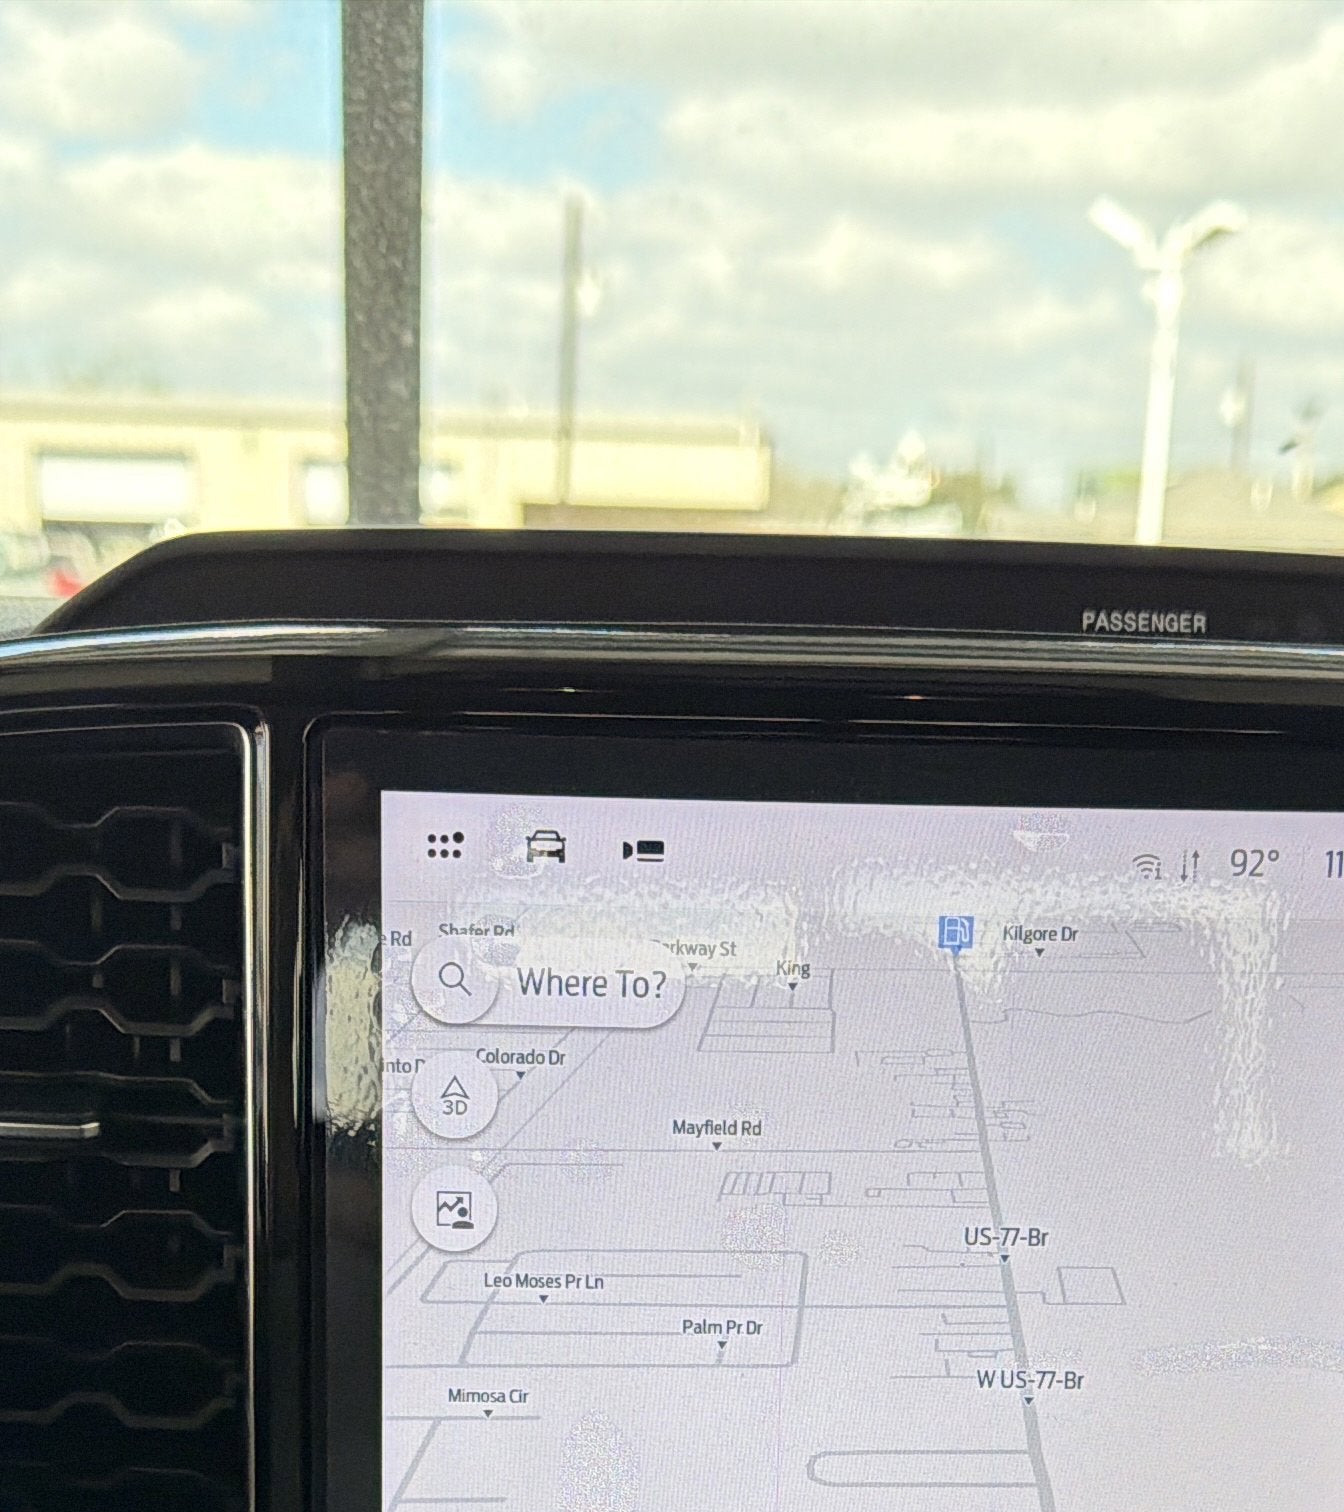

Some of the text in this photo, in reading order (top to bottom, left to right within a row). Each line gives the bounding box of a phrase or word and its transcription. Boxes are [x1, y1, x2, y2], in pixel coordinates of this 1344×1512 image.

[1082, 609, 1206, 634] PASSENGER
[390, 930, 412, 947] Rd
[1002, 924, 1079, 945] Kilgore Dr
[719, 941, 737, 957] St
[776, 960, 810, 979] King
[517, 967, 668, 999] Where To?
[476, 1047, 566, 1066] Colorado Dr
[443, 1100, 468, 1115] 3D
[672, 1119, 762, 1139] Mayfield Rd
[964, 1228, 1049, 1247] US-77-Br
[484, 1274, 604, 1289] Leo Moses Pr Ln
[682, 1319, 763, 1335] Palm Pr Dr
[977, 1371, 1084, 1390] W US-77-Br
[448, 1388, 529, 1403] Mimosa Cir
